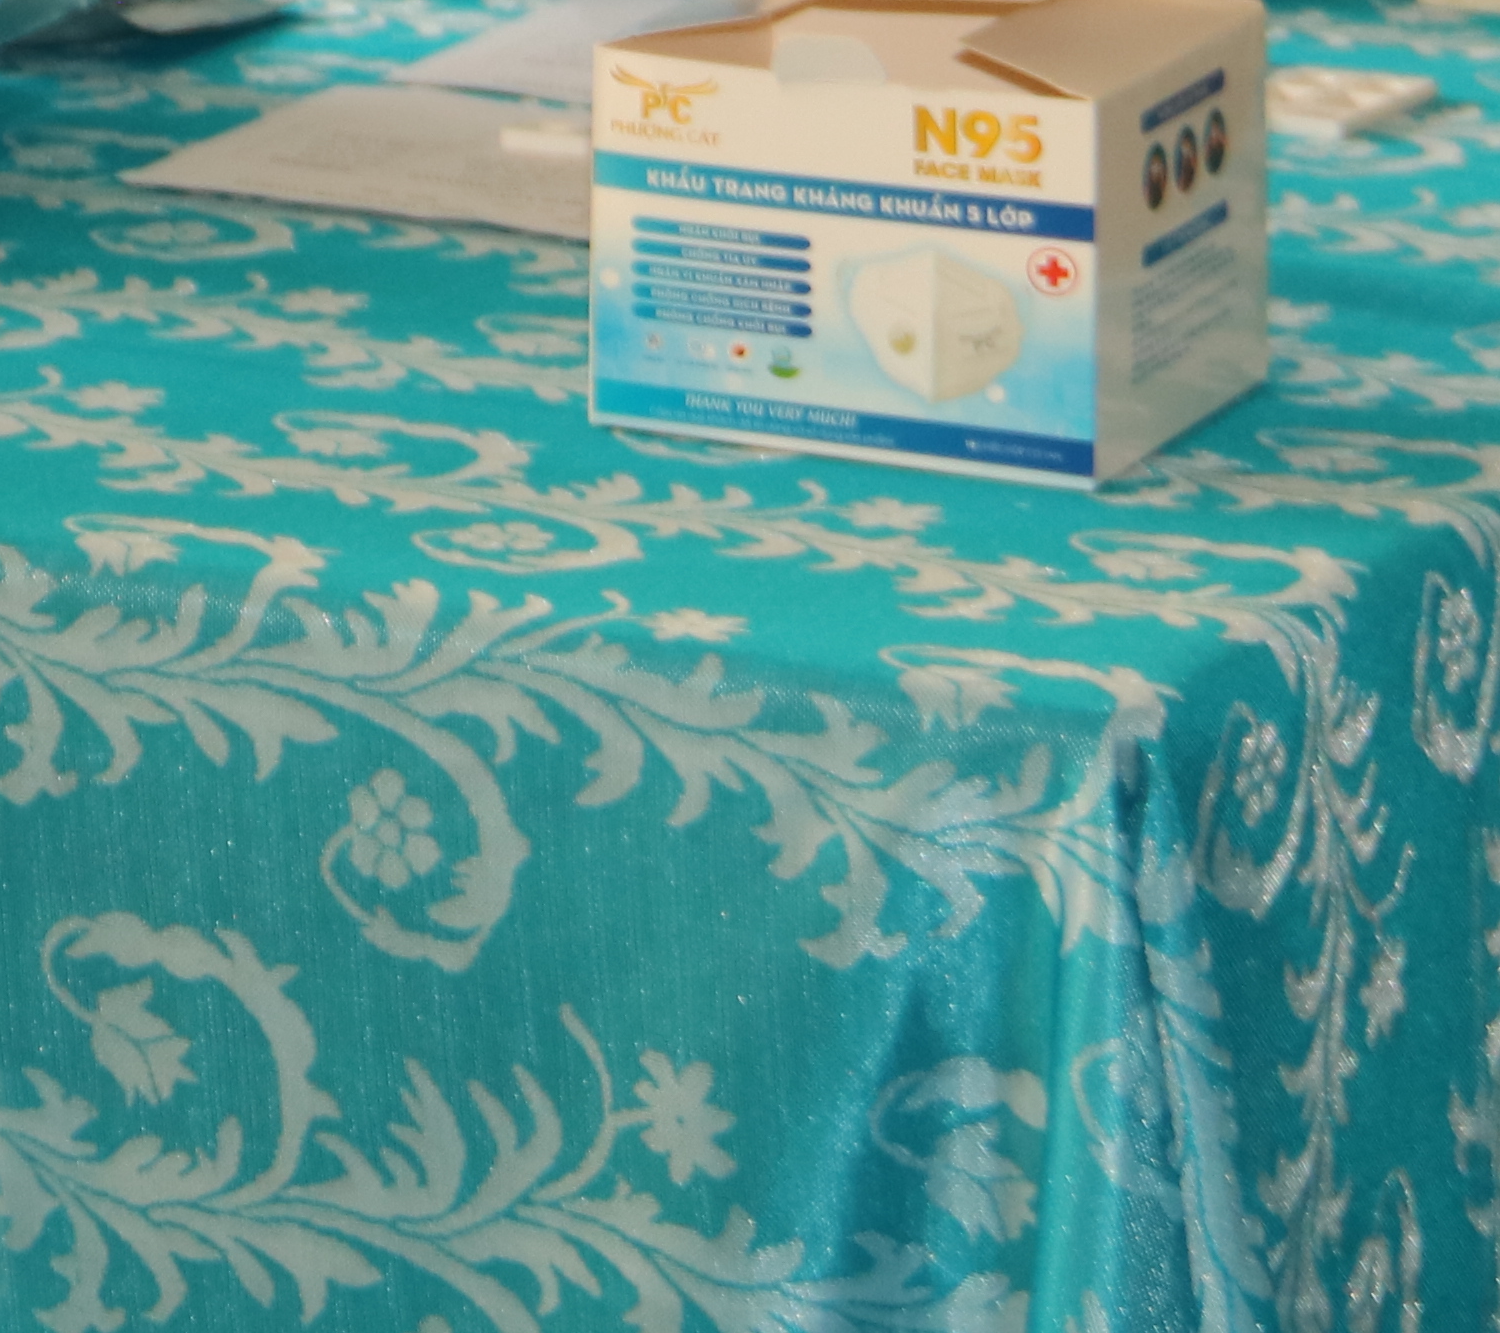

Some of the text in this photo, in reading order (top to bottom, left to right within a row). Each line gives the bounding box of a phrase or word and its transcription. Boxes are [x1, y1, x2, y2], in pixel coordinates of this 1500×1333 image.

[912, 104, 1043, 164] N95
[913, 158, 1042, 188] FACE MASK
[712, 176, 787, 202] TRANG
